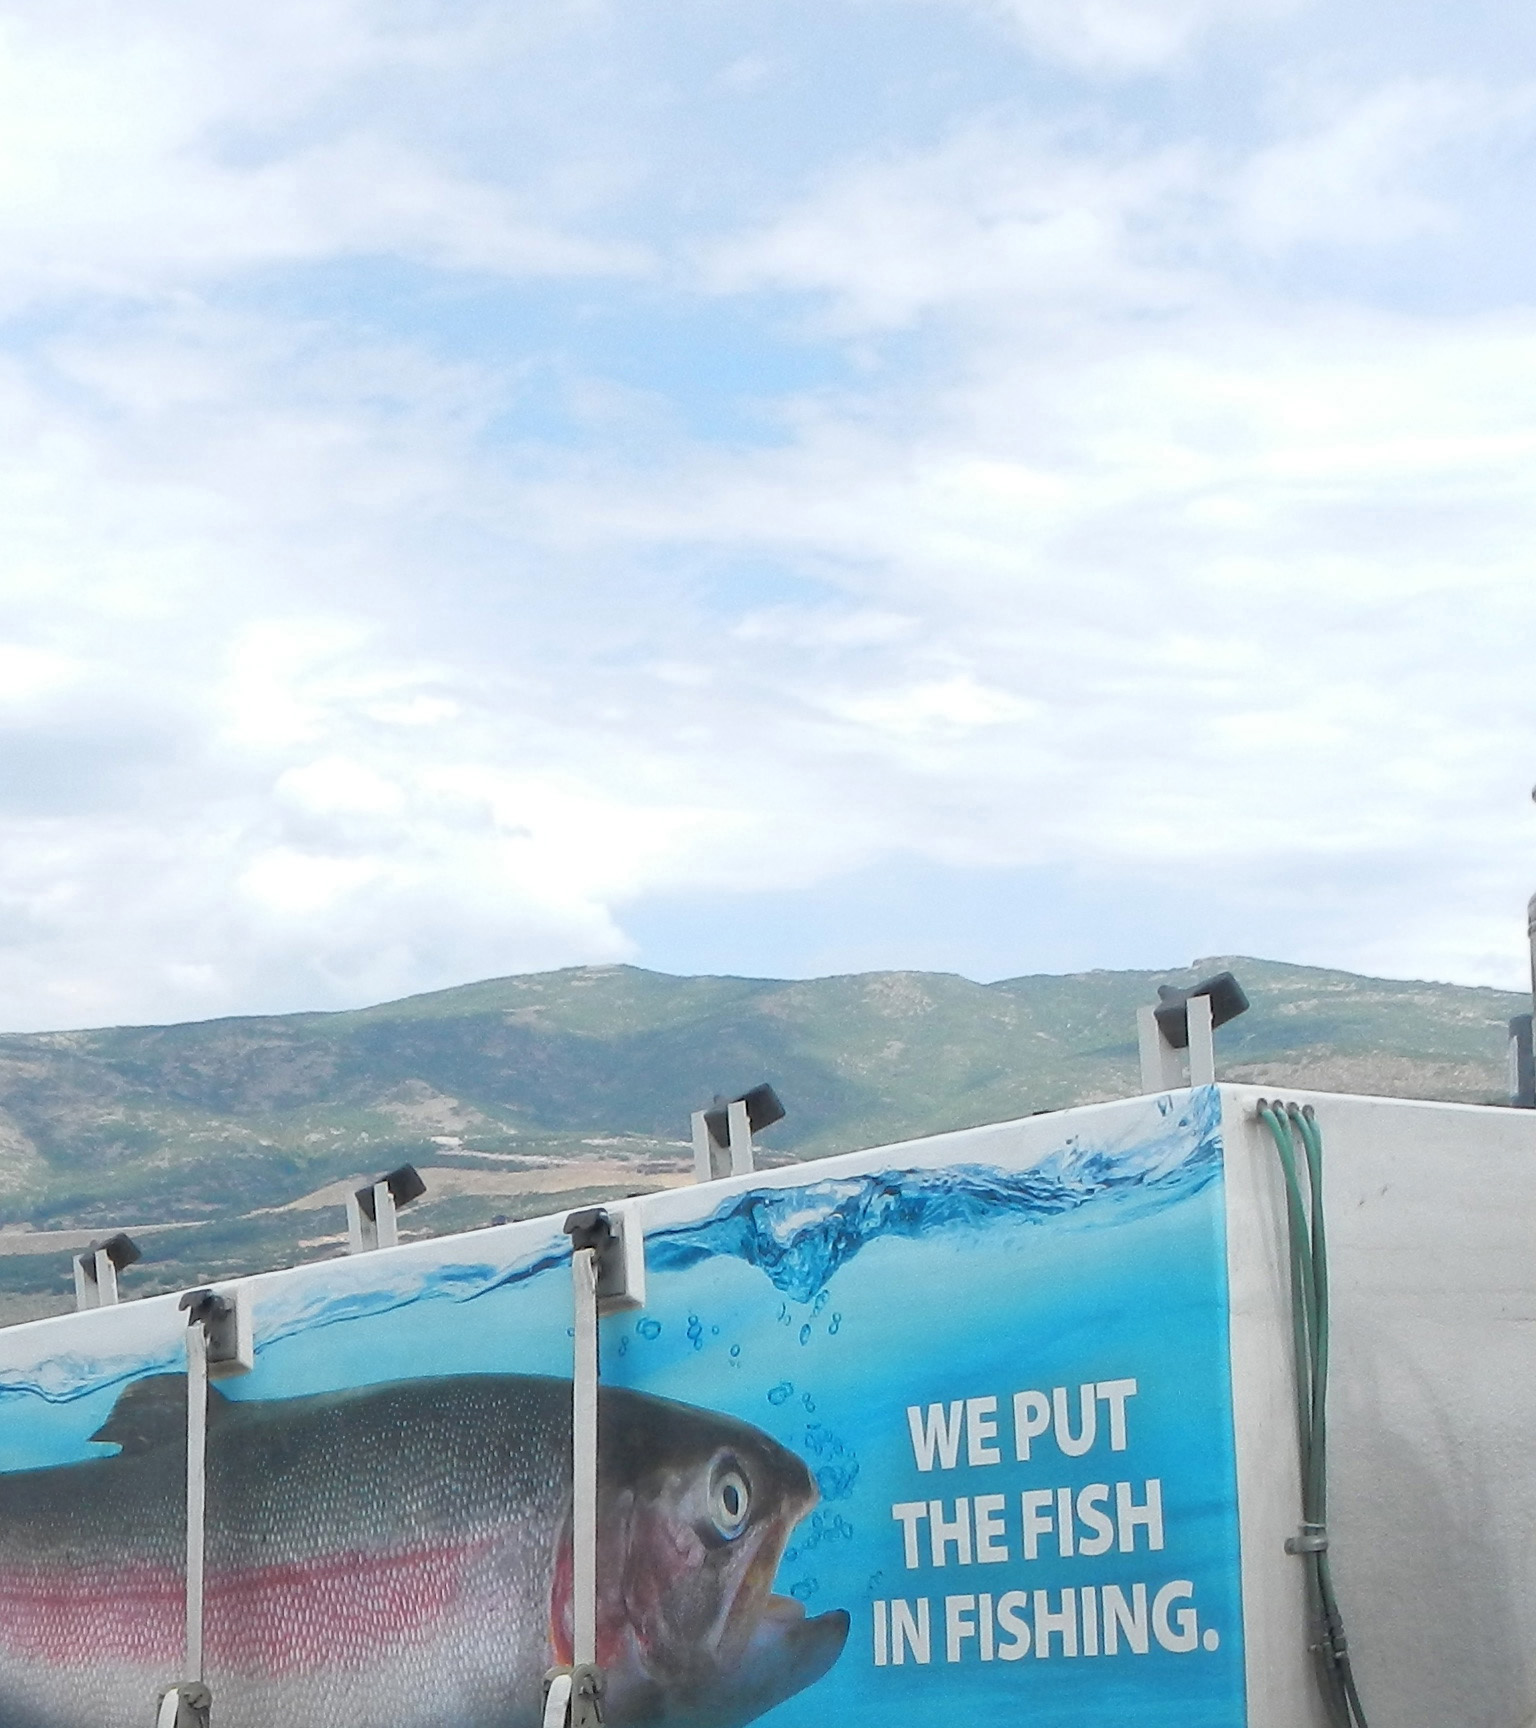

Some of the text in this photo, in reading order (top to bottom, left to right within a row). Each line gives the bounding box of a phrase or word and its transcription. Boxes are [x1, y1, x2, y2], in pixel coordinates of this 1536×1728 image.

[907, 1379, 1137, 1472] WE PUT
[892, 1479, 1165, 1569] THE FISH
[872, 1580, 1220, 1667] IN FISHING.
